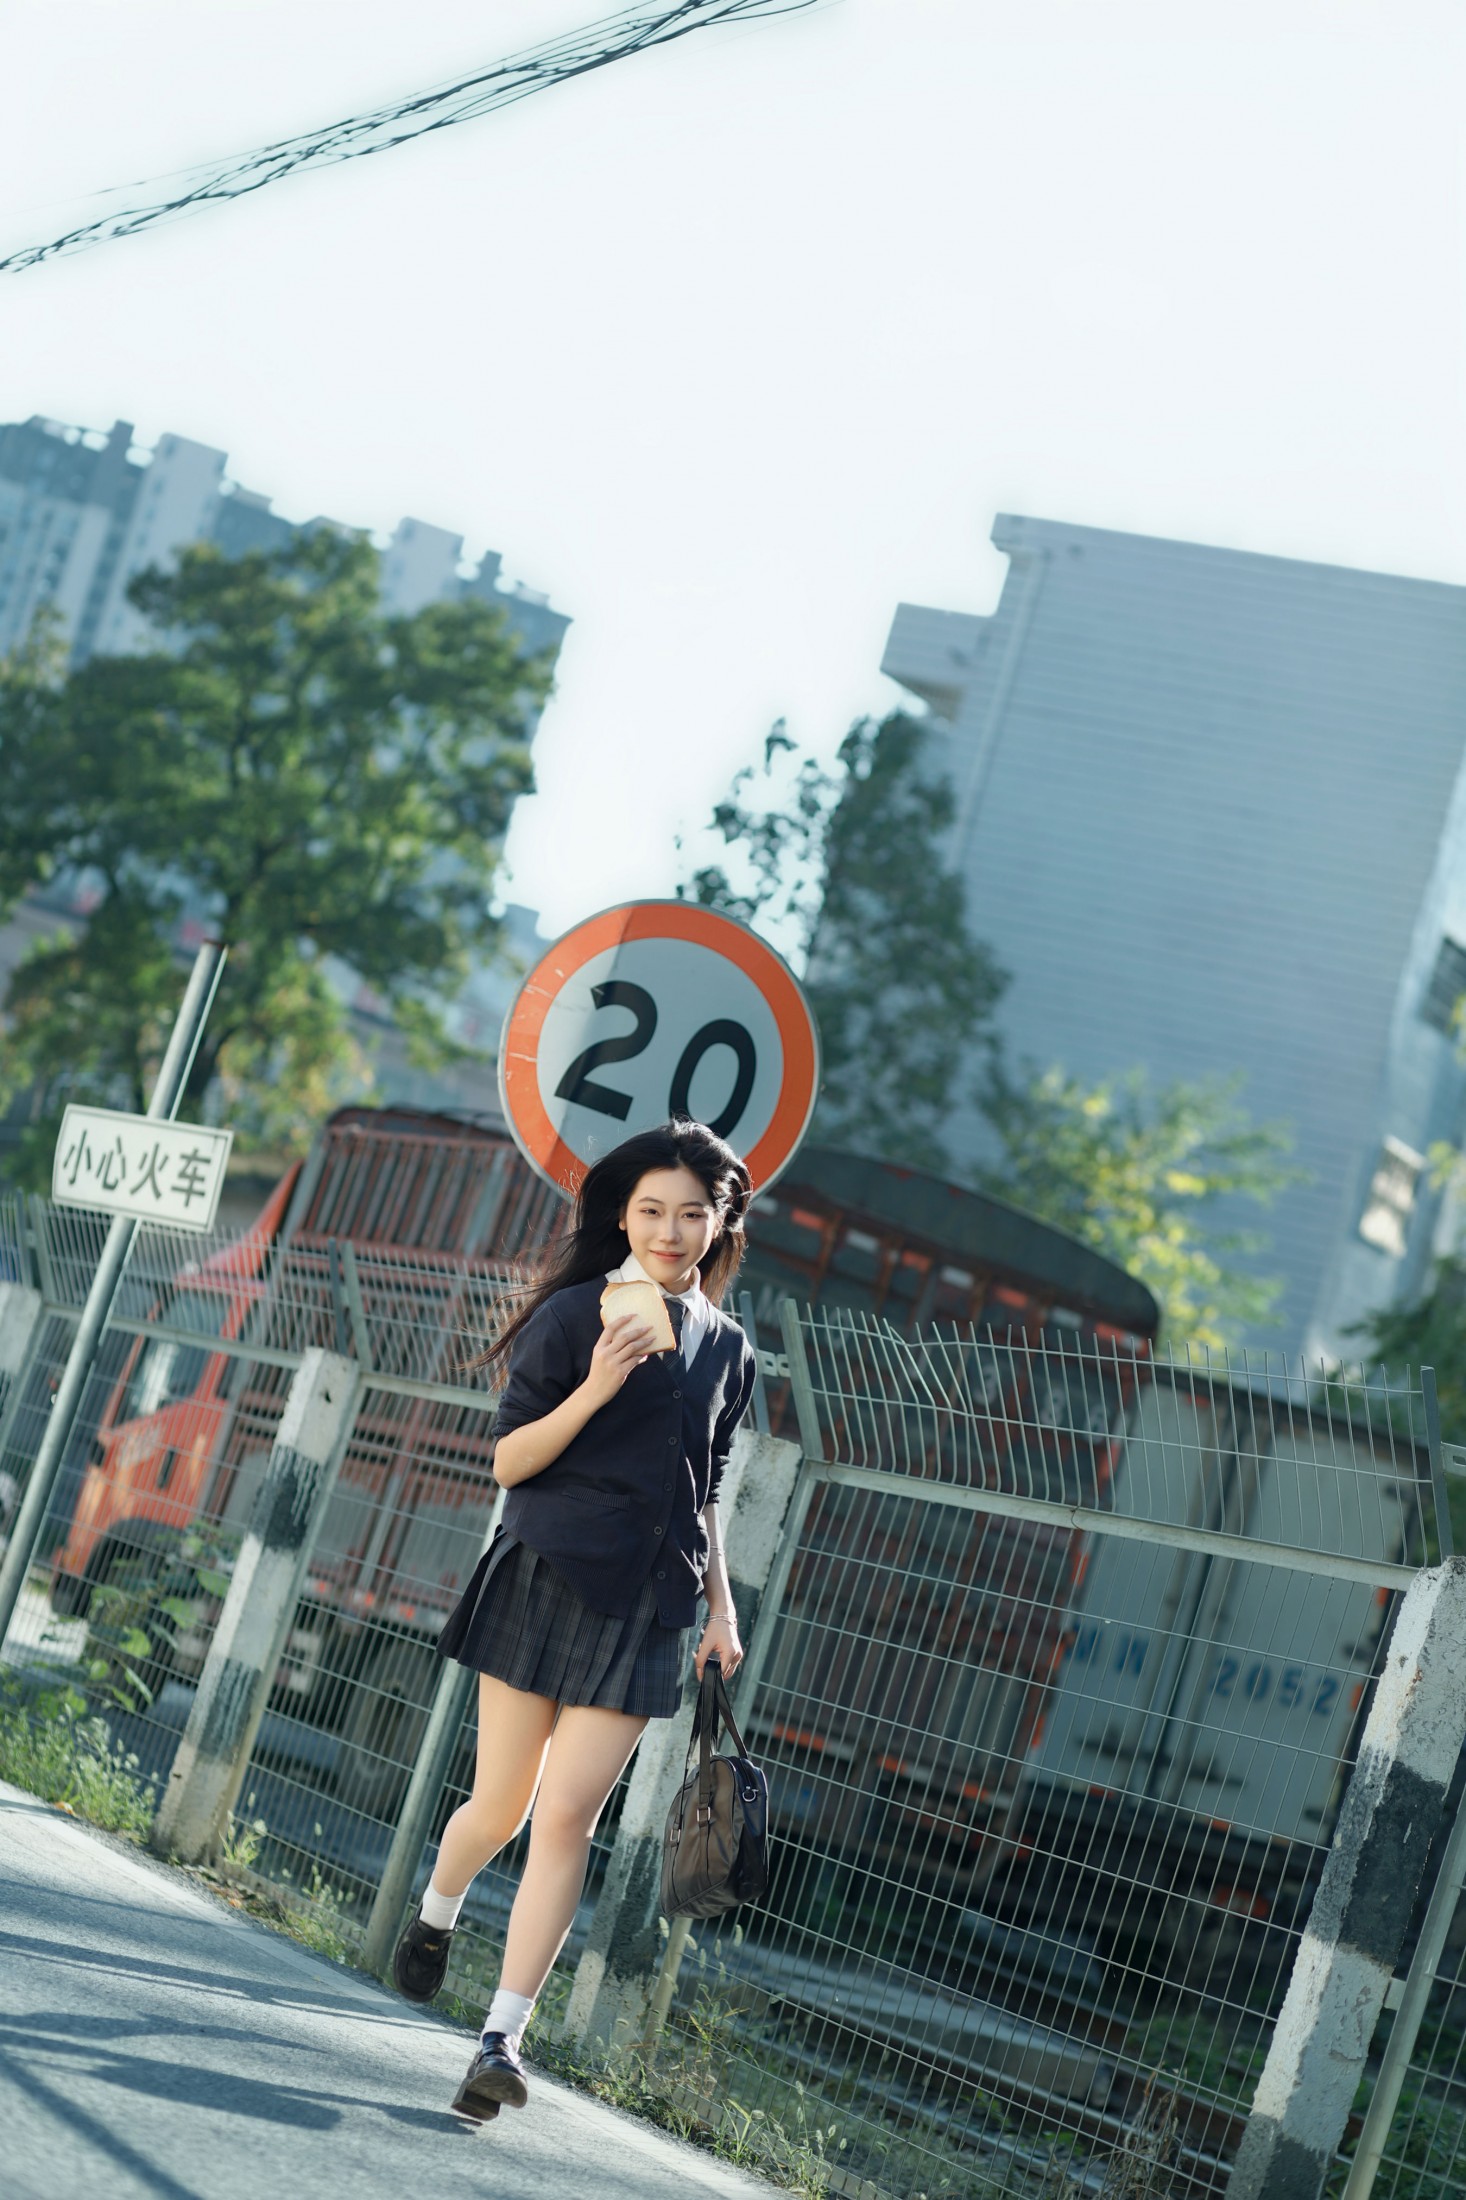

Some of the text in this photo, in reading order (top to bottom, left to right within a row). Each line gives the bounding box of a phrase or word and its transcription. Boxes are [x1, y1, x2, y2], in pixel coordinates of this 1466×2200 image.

[554, 980, 757, 1139] 20
[63, 1128, 212, 1208] 小心火车
[1208, 1657, 1340, 1716] 2052
